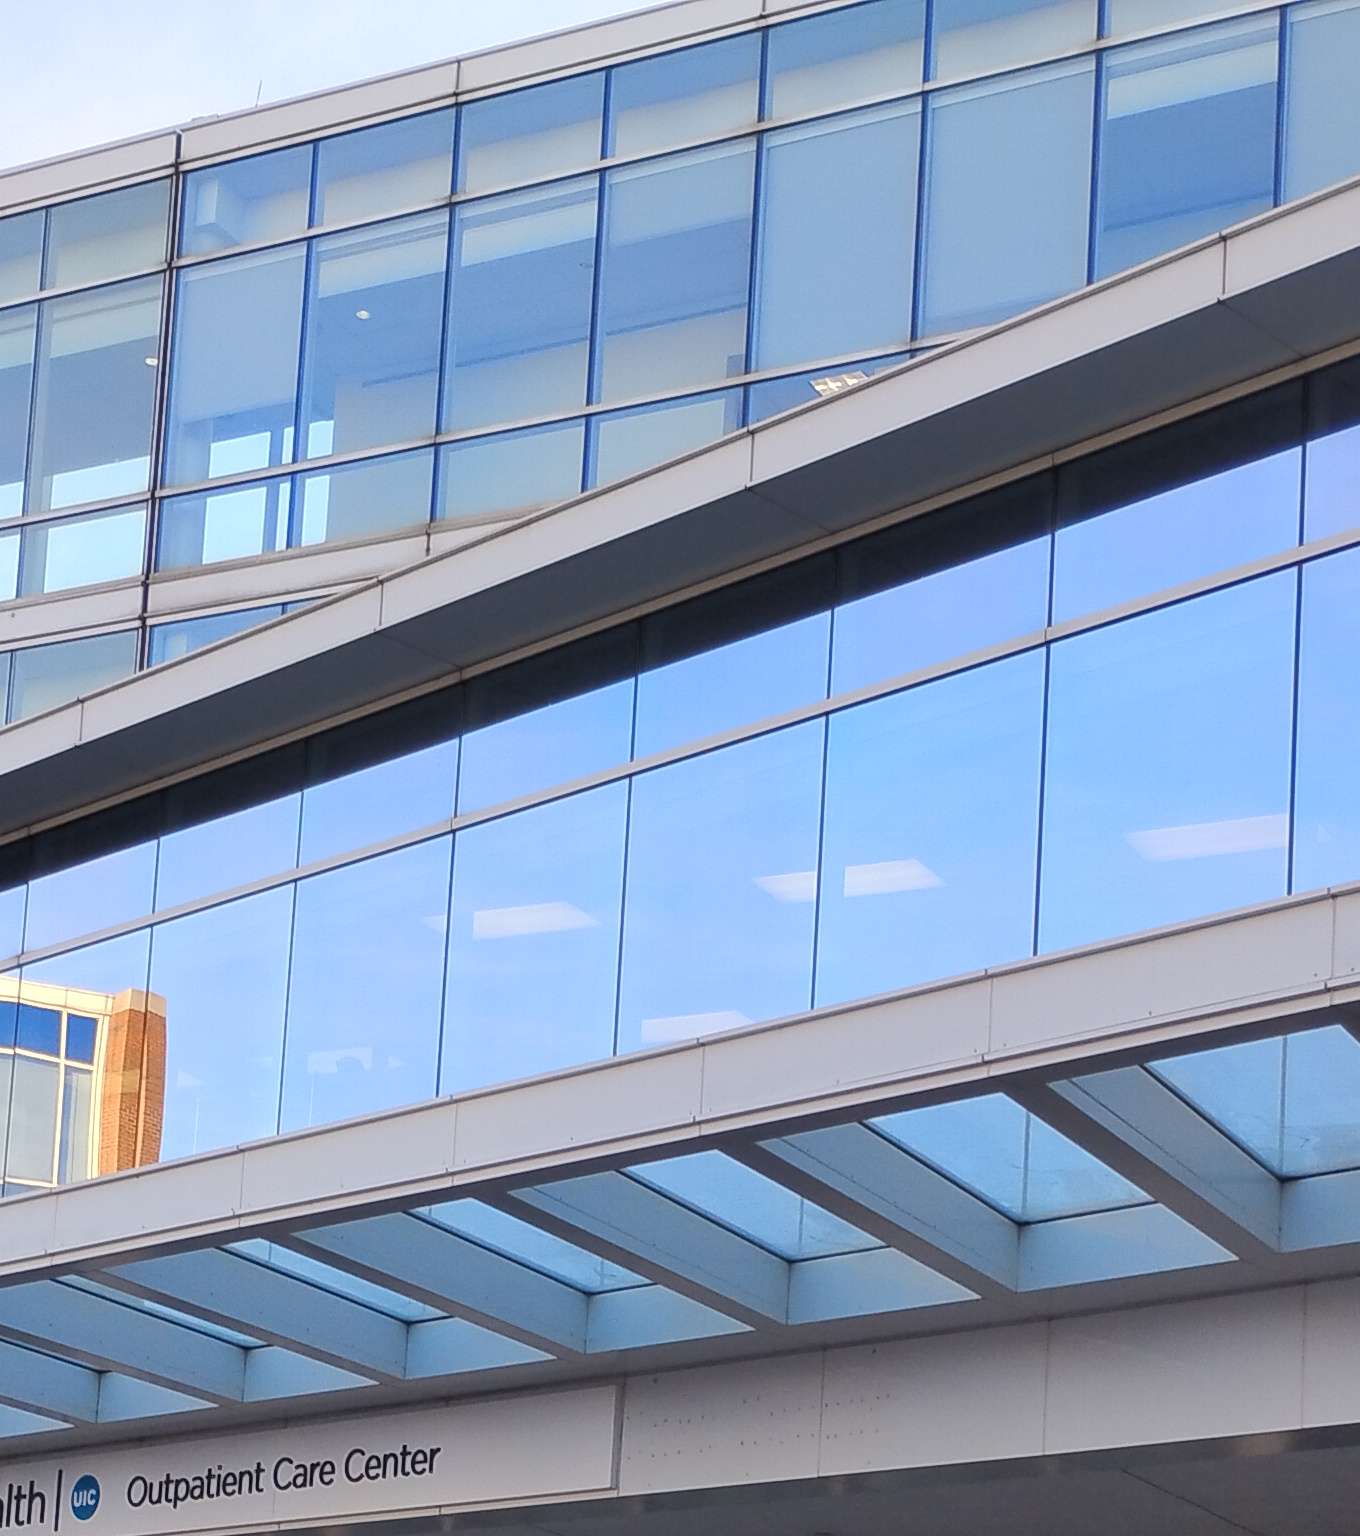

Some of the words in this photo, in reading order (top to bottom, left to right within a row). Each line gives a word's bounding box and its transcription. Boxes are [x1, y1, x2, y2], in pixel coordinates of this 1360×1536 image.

[73, 1488, 97, 1508] UIC
[127, 1461, 265, 1509] Outpatient
[273, 1457, 336, 1491] Care
[344, 1444, 442, 1483] Center
